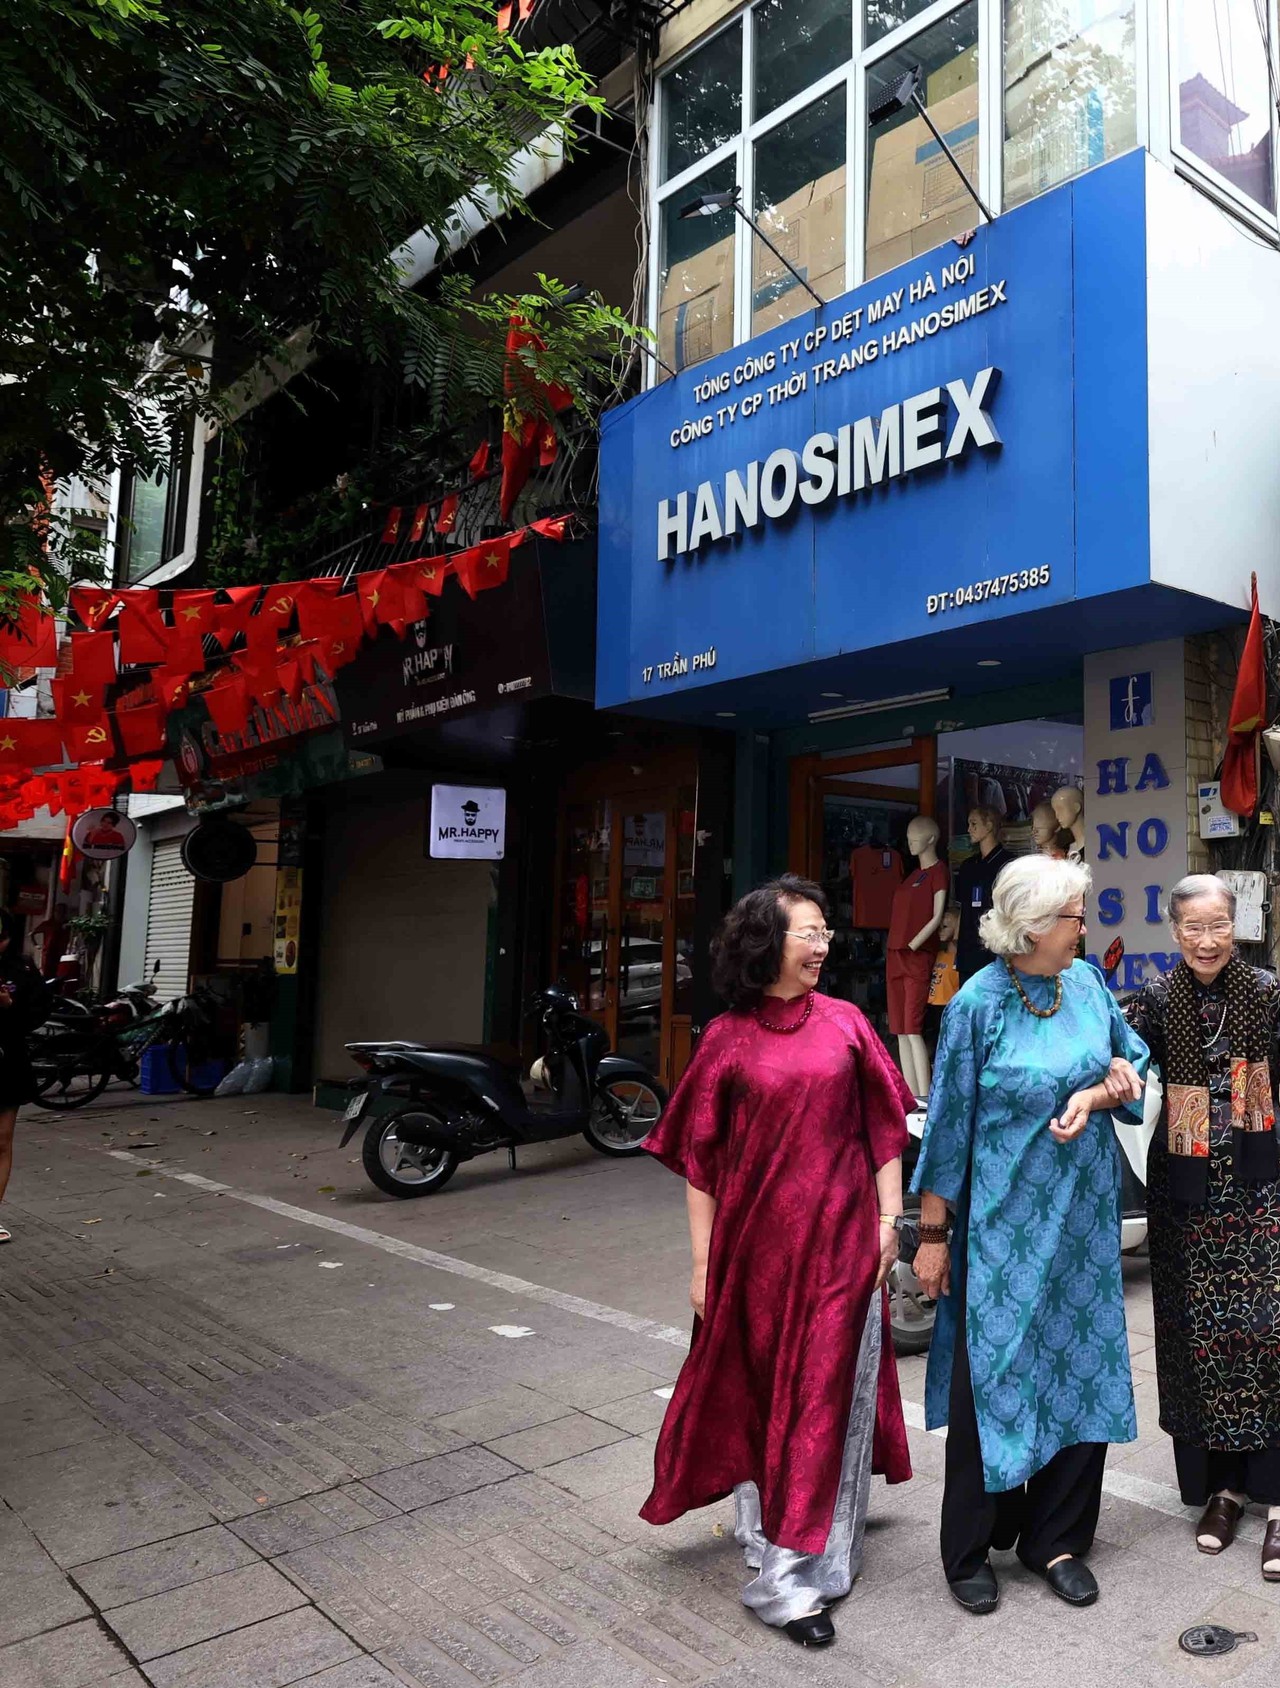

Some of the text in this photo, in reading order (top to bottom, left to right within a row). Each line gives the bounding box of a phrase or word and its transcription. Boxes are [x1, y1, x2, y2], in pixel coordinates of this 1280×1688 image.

[670, 280, 1007, 448] CÔNG TY CP THỜI TRANG HANOSIMEX
[693, 253, 975, 404] TỔNG CÔNG TY CP DỆT MAY HÀ NỘI
[657, 366, 1003, 562] HANOSIMEX
[926, 564, 1052, 615] ĐT:0437475385
[642, 646, 716, 683] 17 TRẦN PHÚ
[439, 827, 499, 843] MR.HAPPY
